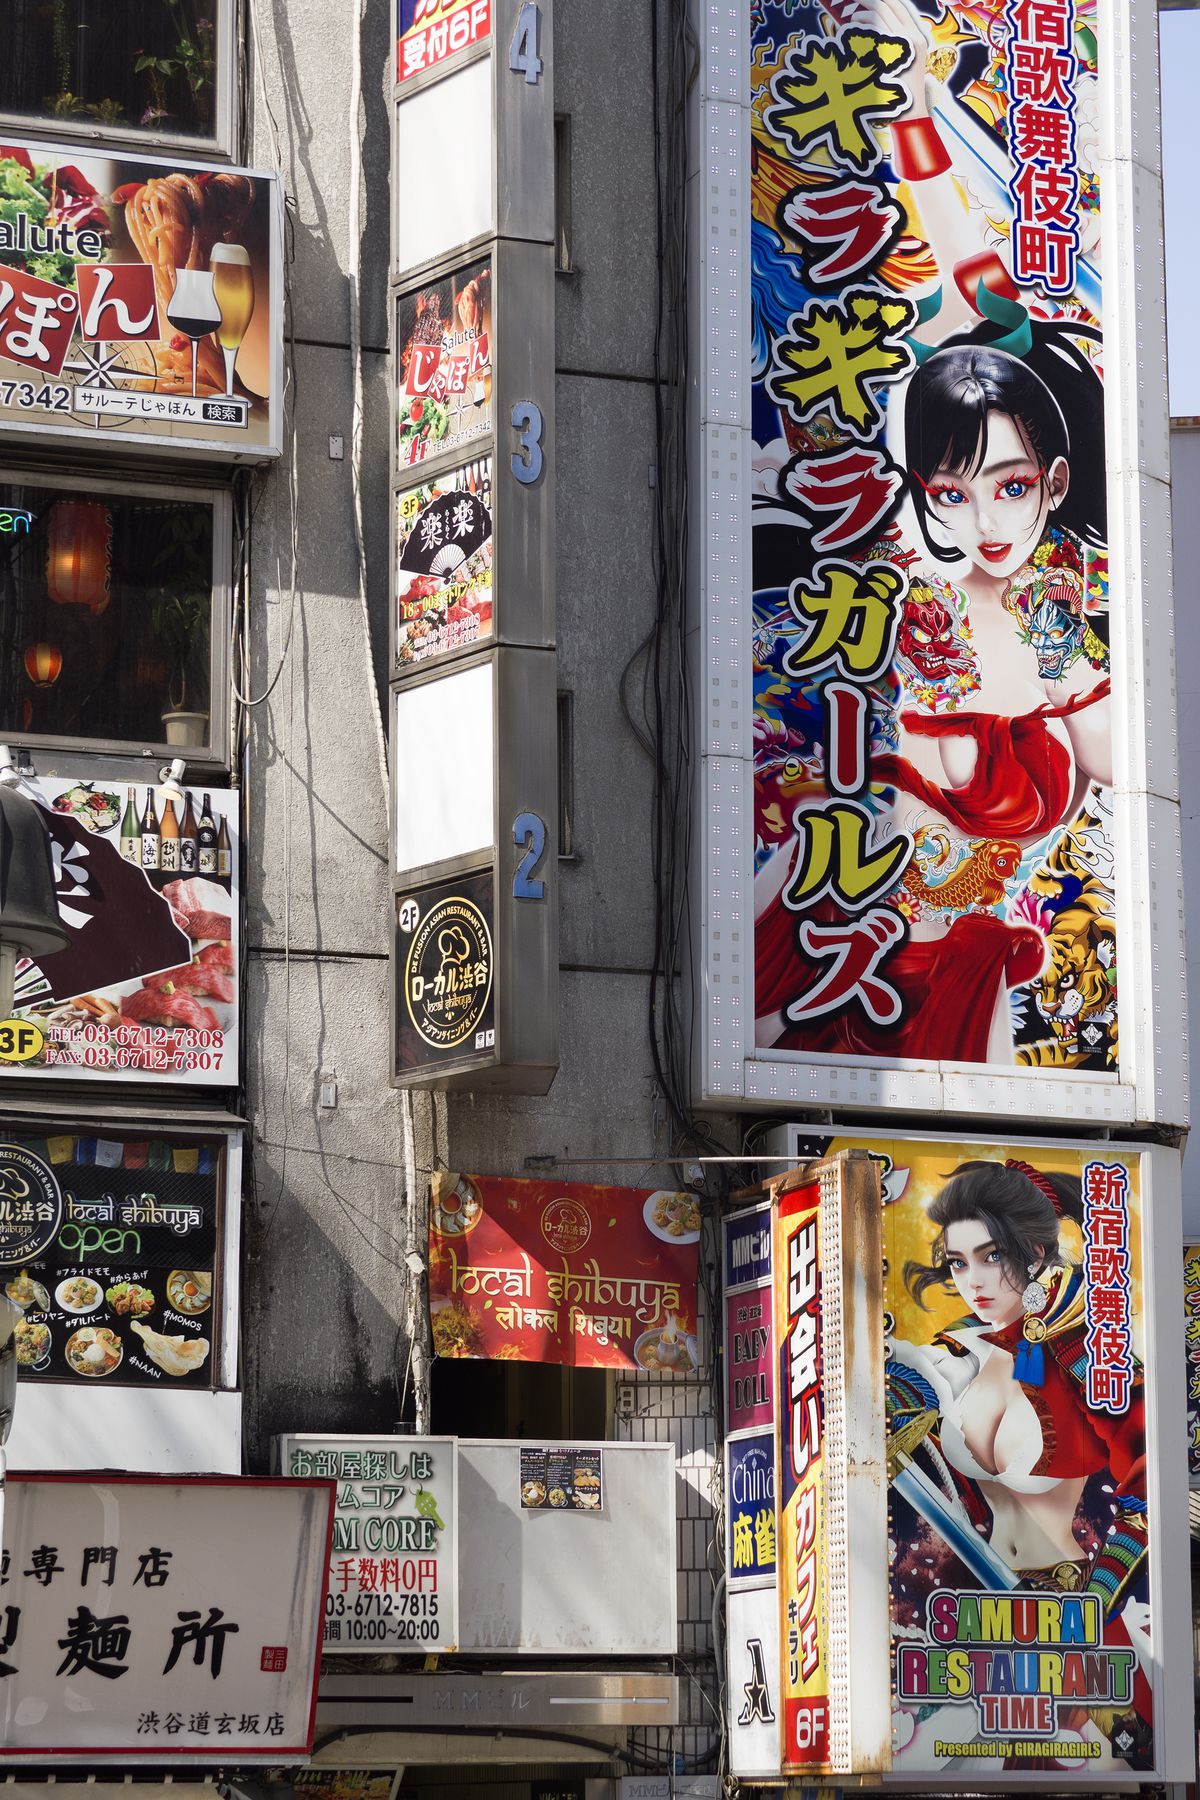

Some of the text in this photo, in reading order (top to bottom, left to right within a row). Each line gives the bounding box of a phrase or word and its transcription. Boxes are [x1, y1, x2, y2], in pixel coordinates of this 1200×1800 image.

[509, 2, 541, 84] 4
[441, 326, 475, 352] Salute
[414, 341, 489, 400] じゃぽん
[207, 403, 236, 421] 検索
[511, 402, 542, 483] 3
[403, 499, 416, 515] 3F
[776, 32, 912, 1023] ギラギラガールズ
[512, 812, 544, 898] 2
[402, 907, 416, 931] 2F
[414, 926, 431, 959] FUSION
[430, 909, 446, 928] ASIAN
[447, 906, 480, 930] RESTAURANT
[412, 960, 488, 1001] ローカル渋谷
[0, 1027, 33, 1053] 3F
[85, 1024, 223, 1049] 03-6712-7308
[84, 1047, 223, 1071] 03-6712-7307
[44, 1184, 54, 1199] BAR
[66, 1194, 201, 1233] local shibuya
[58, 1224, 141, 1262] open
[110, 1270, 149, 1283] #からあげ
[449, 1248, 680, 1323] local shibuya
[1088, 1165, 1128, 1407] 新宿歌舞伎町
[163, 1309, 202, 1331] #MOMOS
[734, 1325, 771, 1365] BABY
[128, 1356, 161, 1378] #NAAN
[734, 1373, 770, 1410] DOLL
[291, 1450, 433, 1479] お部屋探しは
[732, 1463, 774, 1504] China
[364, 1516, 436, 1552] CORE
[733, 1508, 775, 1568] 麻雀
[330, 1557, 438, 1593] 手数料0円
[932, 1596, 1096, 1644] SAMURAI
[789, 1599, 798, 1684] キラリ
[902, 1650, 1131, 1697] RESTAURANT
[137, 1711, 285, 1736] 渋谷道玄坂店
[796, 1707, 824, 1749] 6F
[981, 1696, 1053, 1729] TIME
[934, 1740, 1101, 1758] Presented by GIRAGIRAGIRLS
